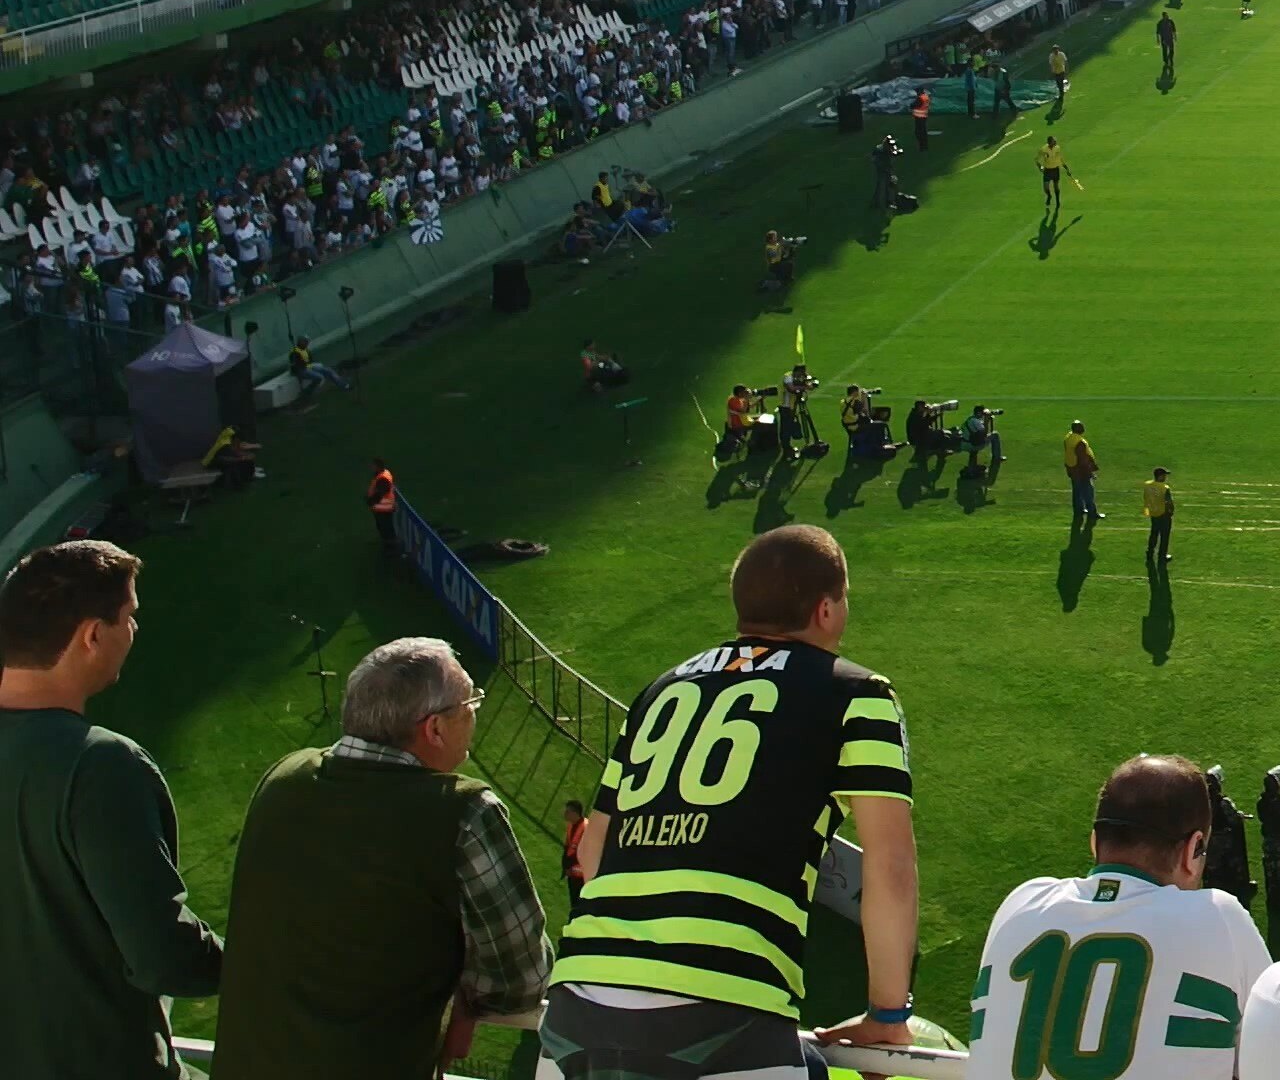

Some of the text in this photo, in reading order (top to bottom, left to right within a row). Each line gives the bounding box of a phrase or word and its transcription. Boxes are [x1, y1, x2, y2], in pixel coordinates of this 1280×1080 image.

[441, 559, 492, 646] CAIXA
[617, 678, 779, 812] 96
[1009, 929, 1153, 1080] 10
